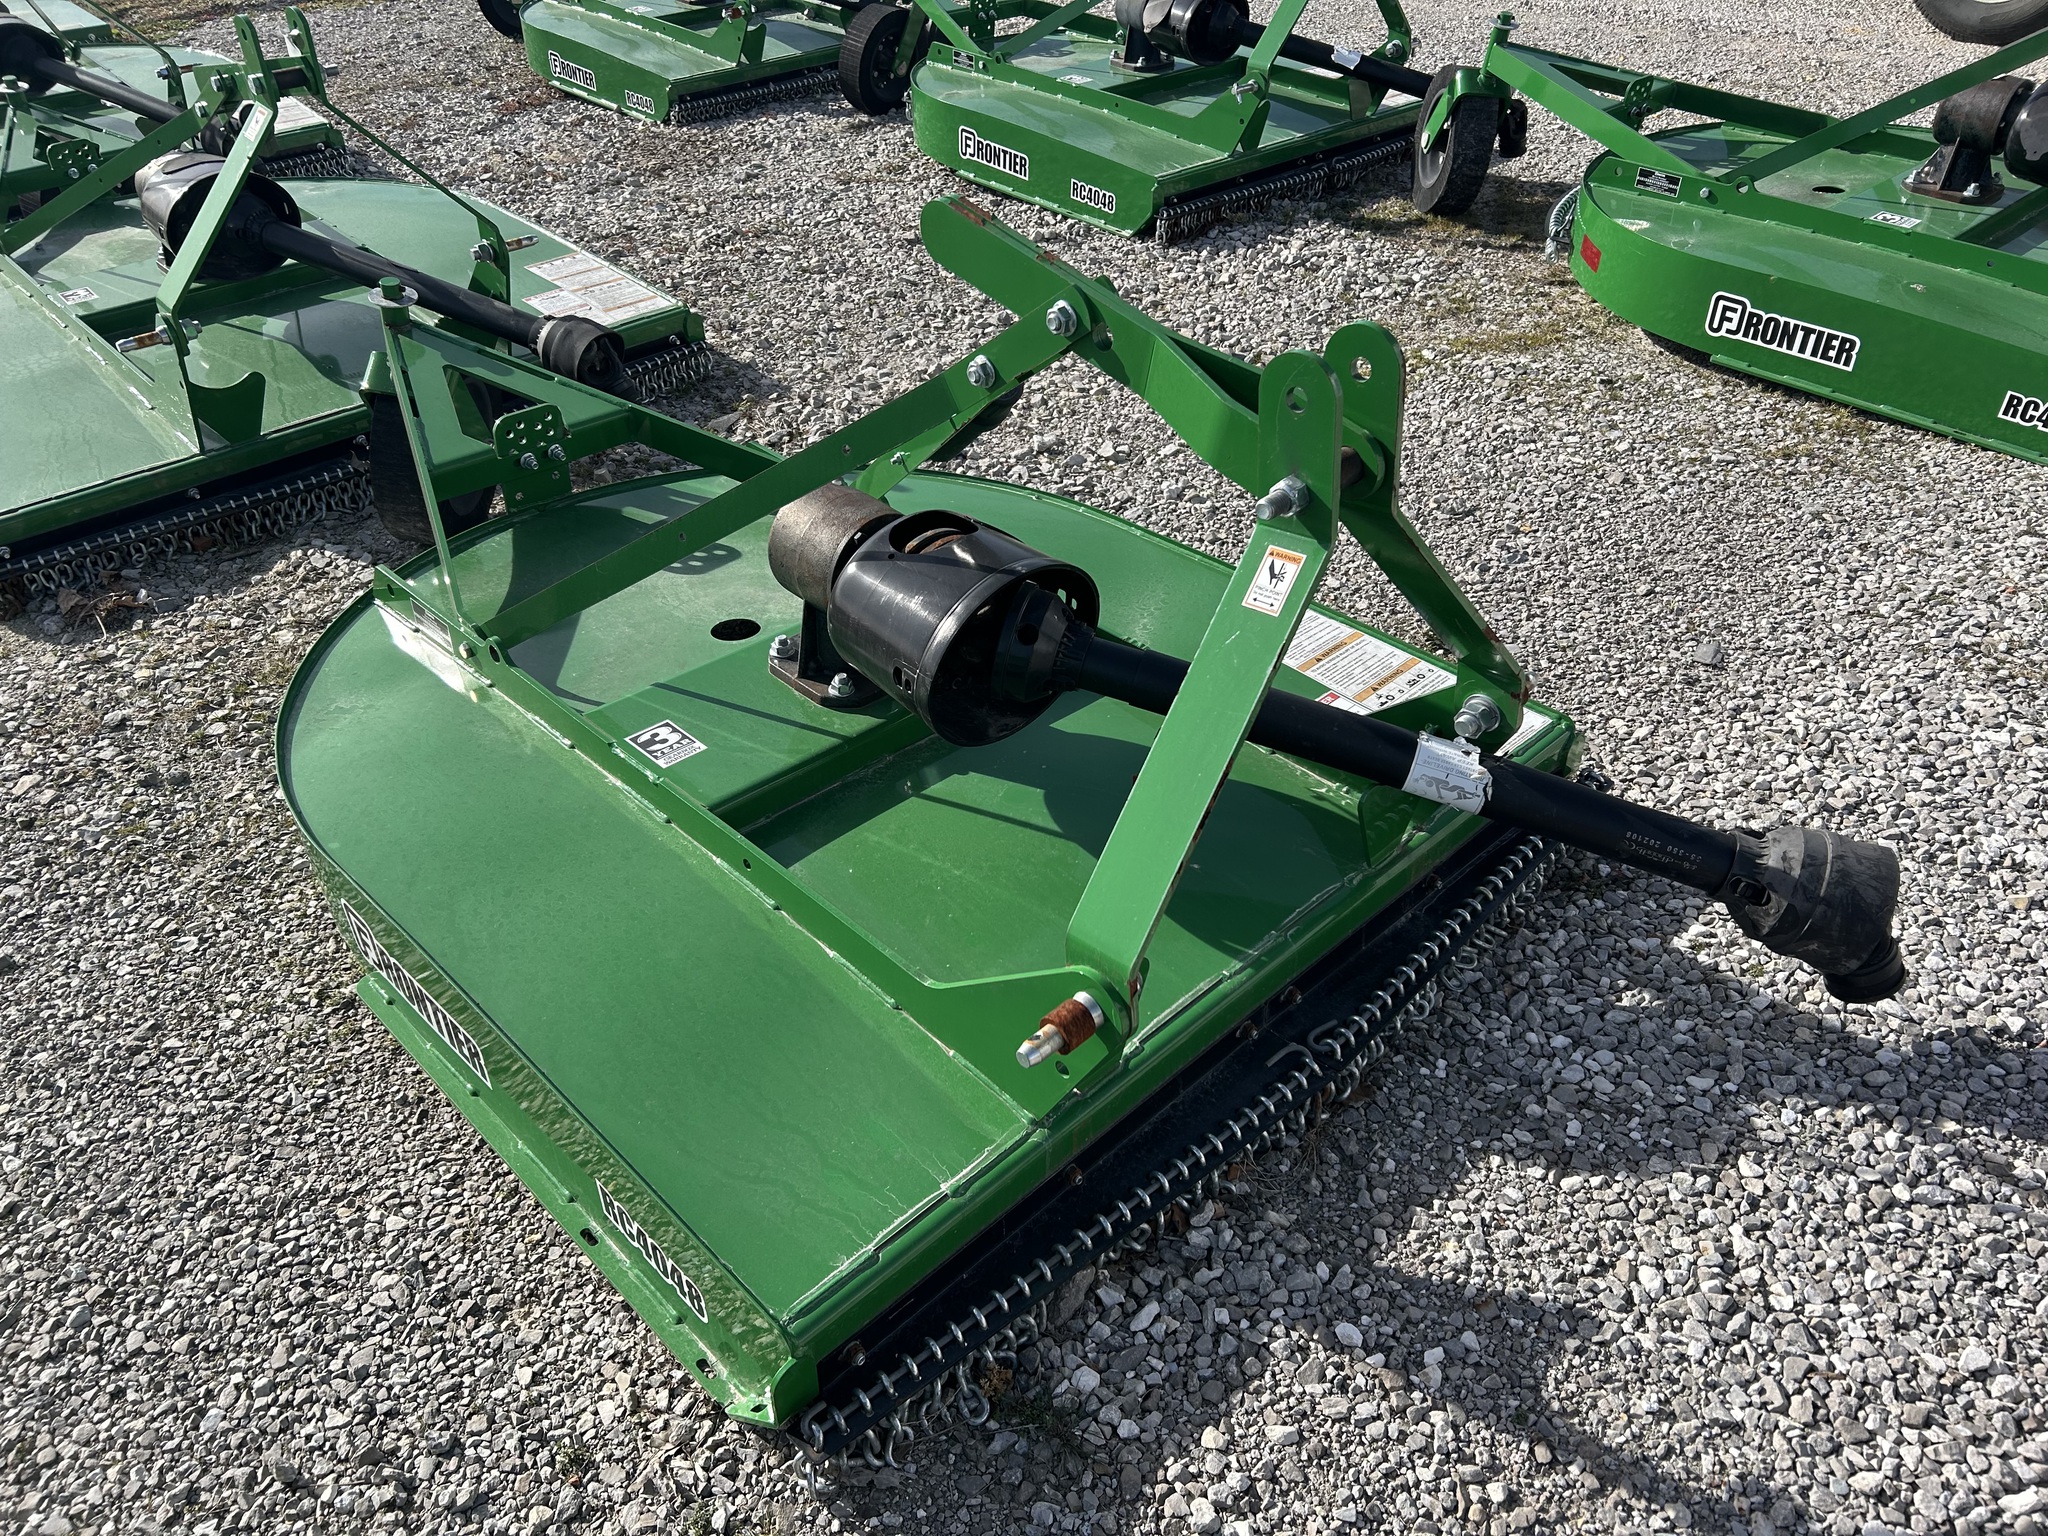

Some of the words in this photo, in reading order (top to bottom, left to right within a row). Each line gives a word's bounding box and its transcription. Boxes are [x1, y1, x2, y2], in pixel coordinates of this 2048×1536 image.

[548, 50, 596, 90] FRONTIER
[625, 91, 654, 113] RC4048
[960, 127, 1028, 179] FRONTIER
[1072, 180, 1116, 213] RC4048
[1707, 294, 1857, 368] FRONTIER
[1274, 551, 1301, 564] WARNING
[1318, 640, 1347, 658] WARNING
[1374, 668, 1404, 687] WARNING
[637, 726, 682, 751] 3
[652, 738, 691, 757] YEAR
[1456, 758, 1474, 766] KEEP
[342, 900, 491, 1088] FRONTIER
[598, 1184, 706, 1319] RC4048
